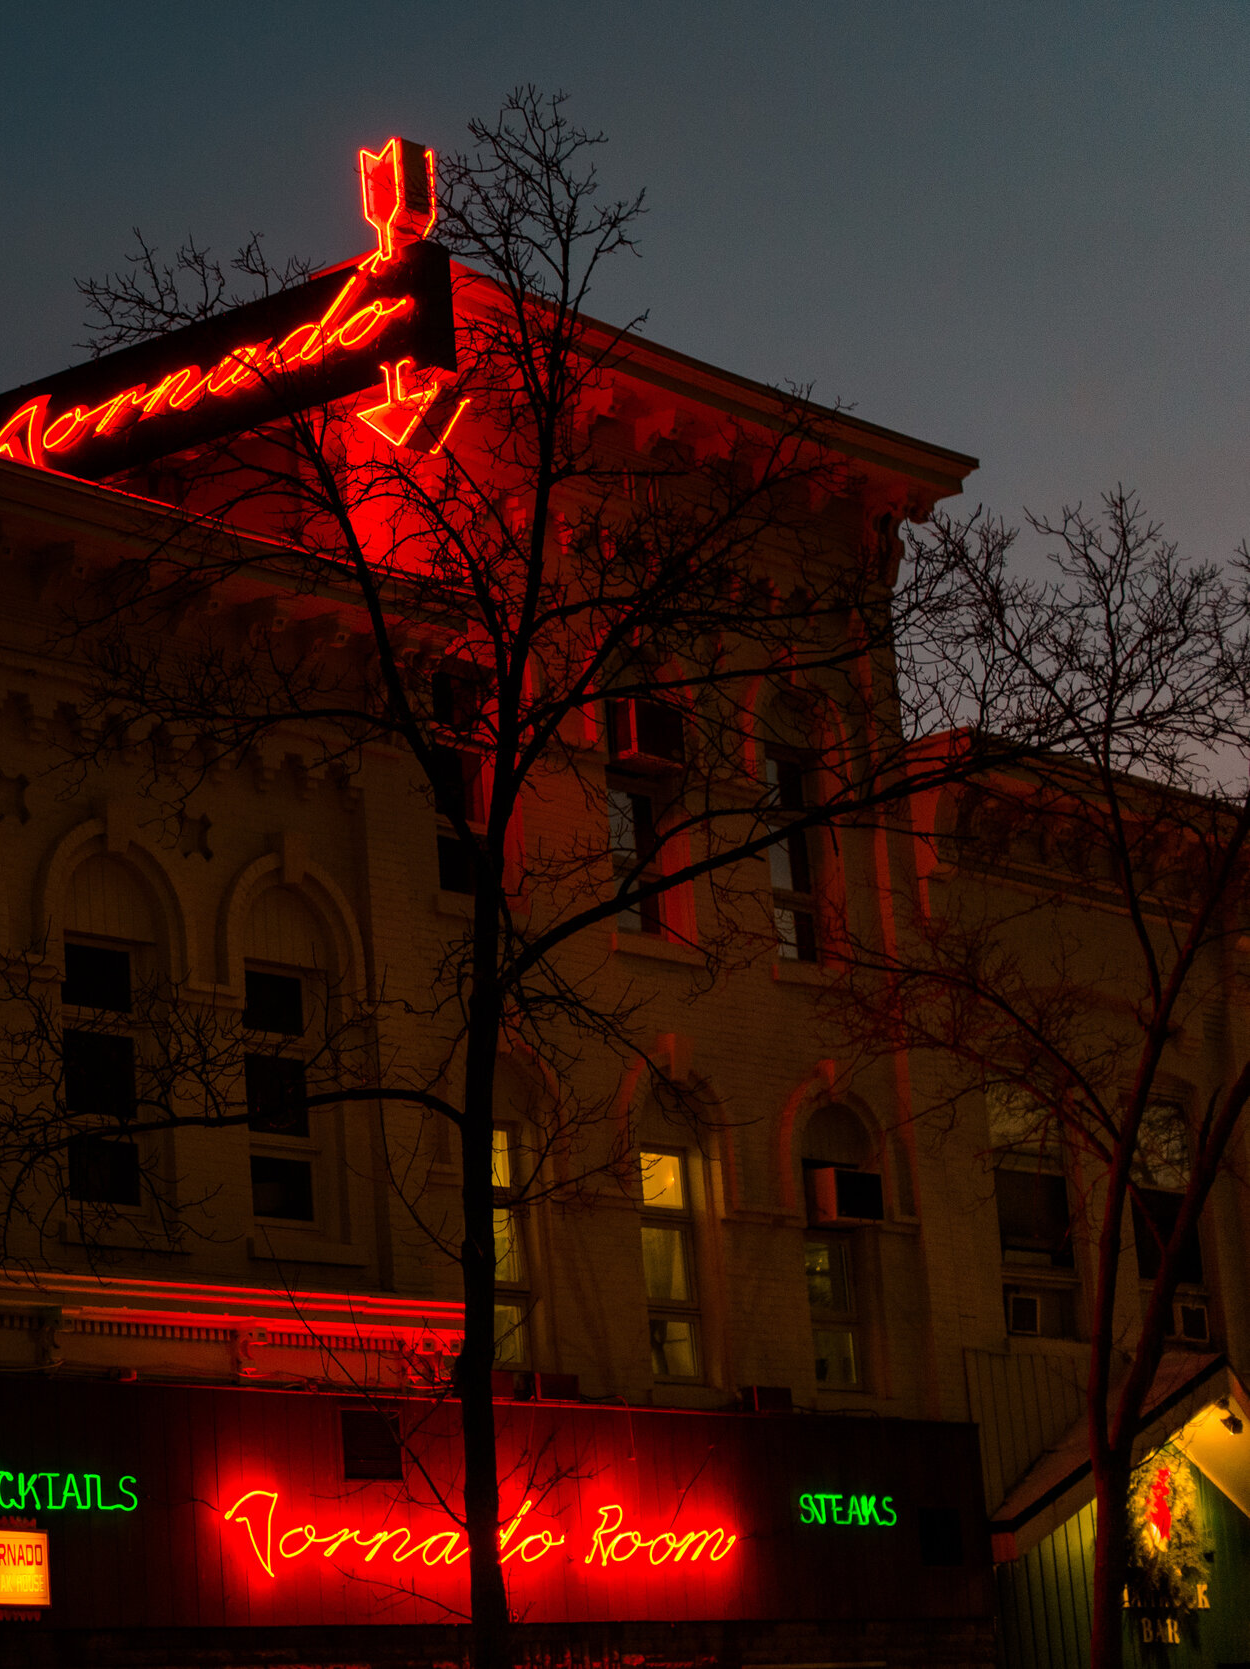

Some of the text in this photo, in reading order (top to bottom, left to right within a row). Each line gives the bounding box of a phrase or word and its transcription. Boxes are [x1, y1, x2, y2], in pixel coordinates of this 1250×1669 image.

[799, 1493, 898, 1526] STEAKS
[585, 1505, 735, 1566] Room
[16, 1574, 44, 1592] HOUSE
[1141, 1617, 1181, 1644] BAR
